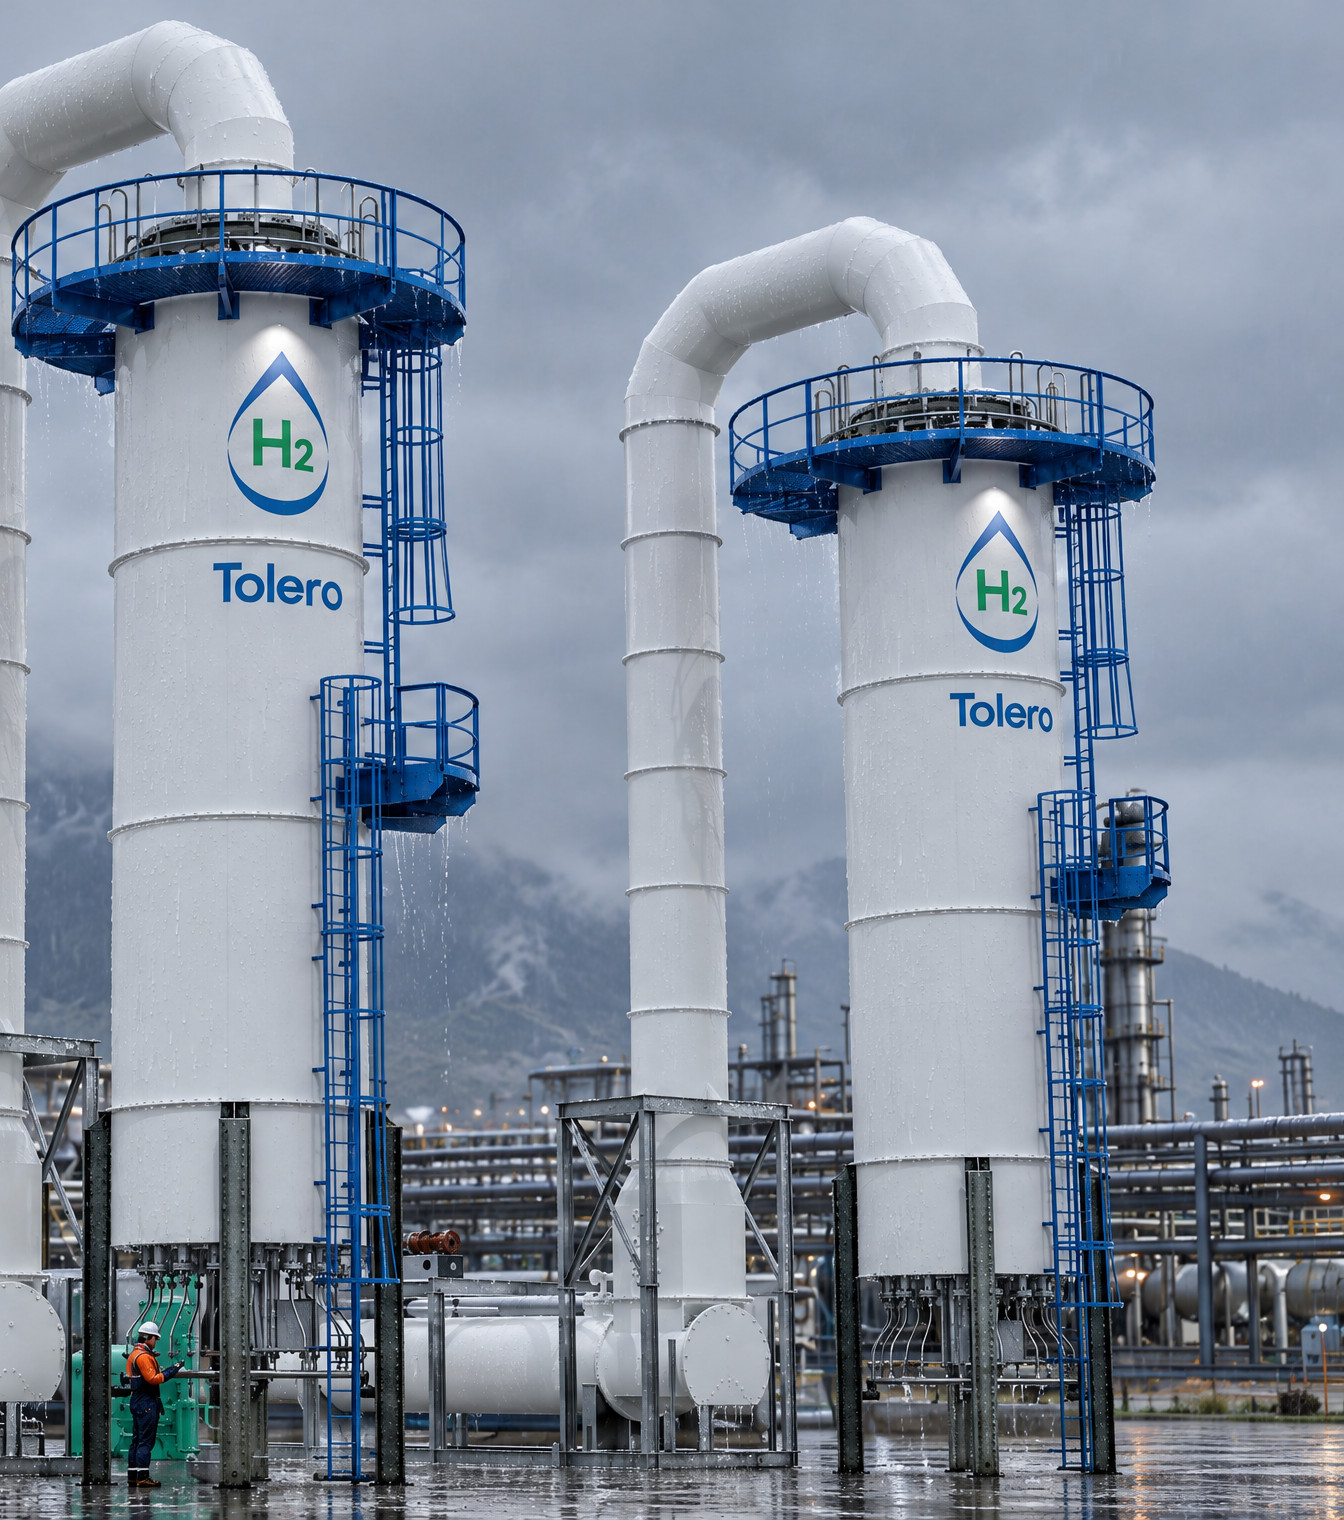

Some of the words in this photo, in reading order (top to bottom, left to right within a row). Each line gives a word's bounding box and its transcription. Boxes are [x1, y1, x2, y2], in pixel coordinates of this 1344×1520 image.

[252, 418, 314, 472] H2
[213, 562, 343, 611] Tolero
[976, 568, 1028, 616] H2
[949, 692, 1053, 733] Tolero
